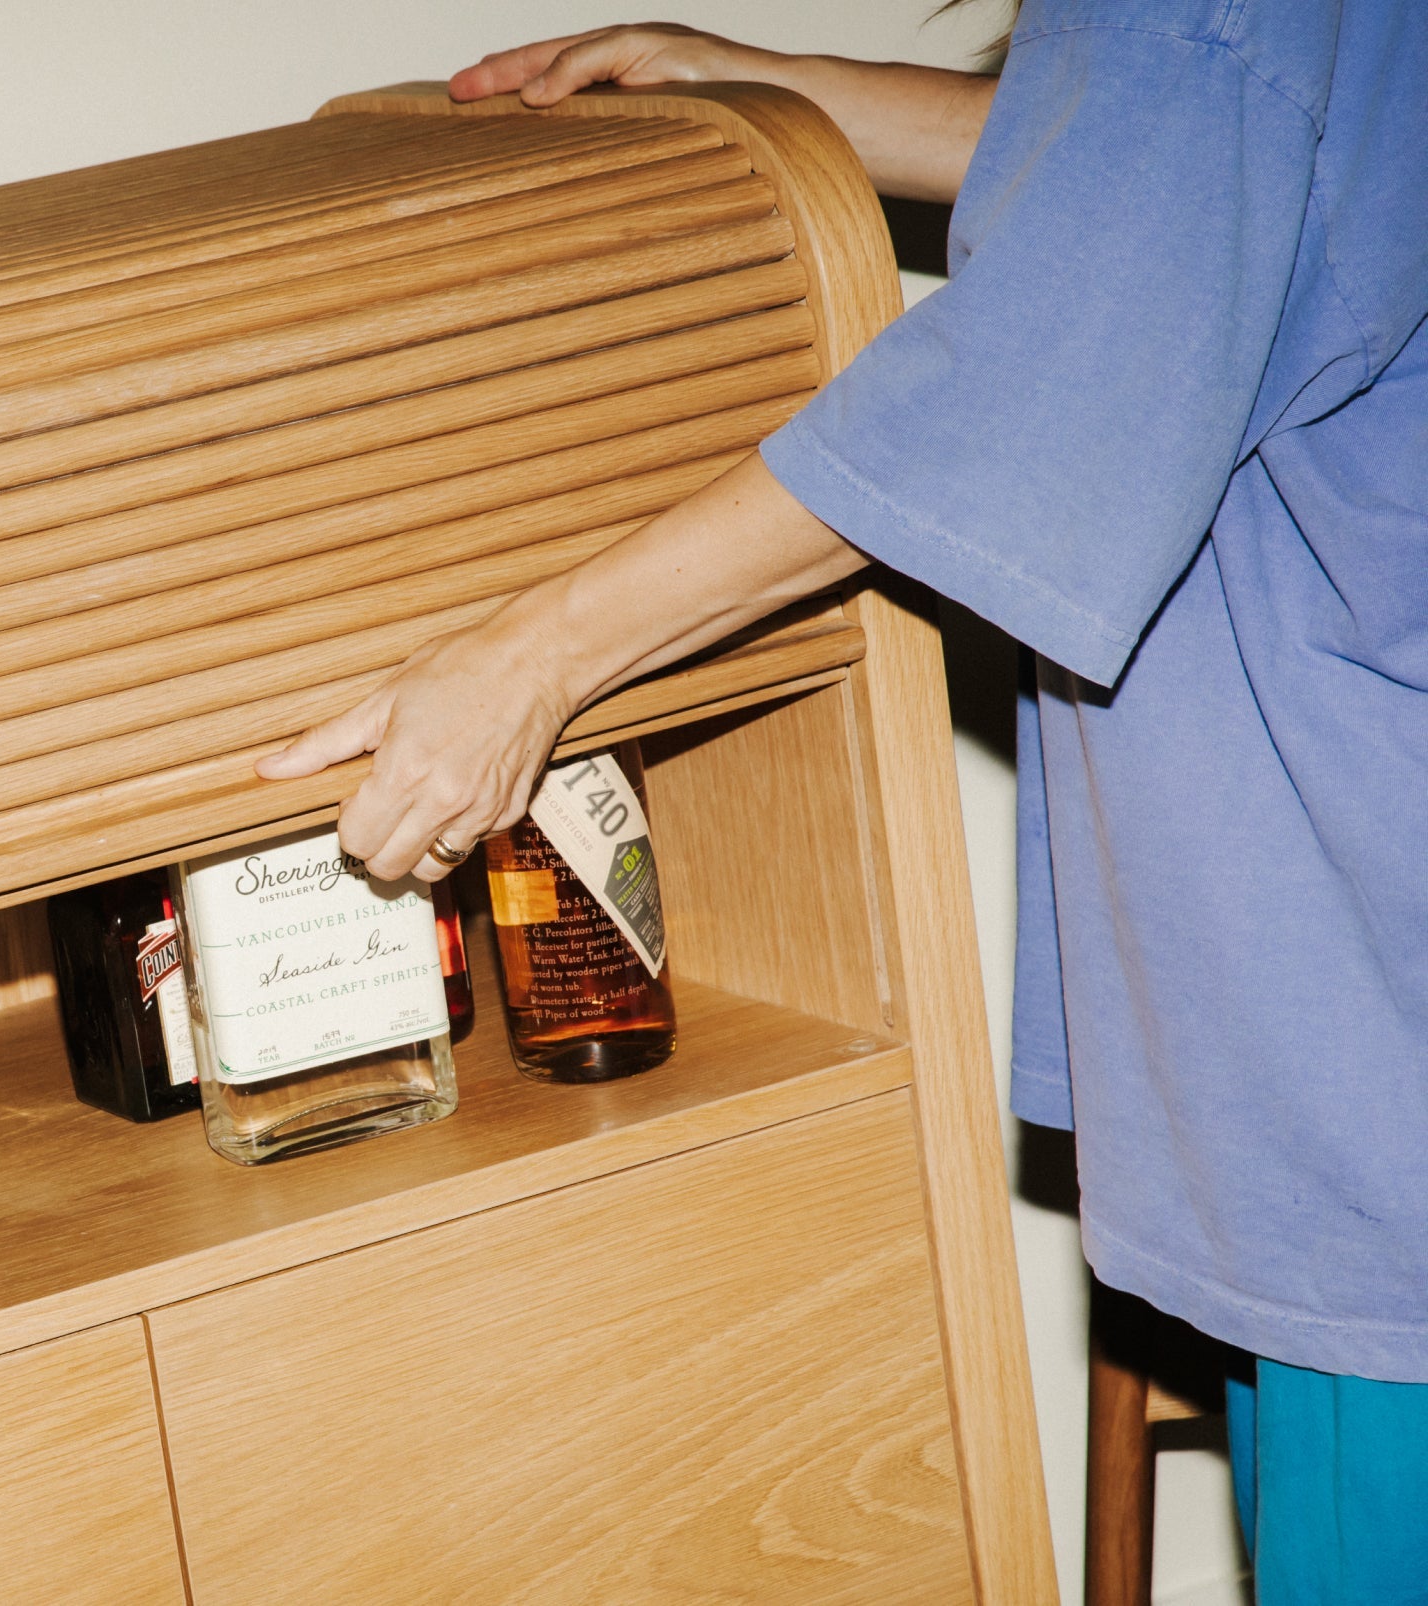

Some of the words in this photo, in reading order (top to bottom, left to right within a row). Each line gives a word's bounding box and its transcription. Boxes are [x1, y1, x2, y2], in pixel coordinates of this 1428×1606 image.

[584, 788, 629, 837] 40
[541, 859, 547, 868] 2
[259, 884, 315, 904] DISTILLERY
[574, 897, 580, 908] 5
[592, 909, 597, 919] 2
[236, 912, 347, 949] VANCOUVER
[355, 895, 418, 921] ISLAND
[545, 926, 593, 938] Percolators
[535, 942, 569, 951] Receiver
[571, 940, 584, 950] for
[586, 933, 619, 951] purified
[260, 952, 347, 988] Seaside
[353, 928, 411, 964] Gin
[532, 954, 556, 965] Warm
[558, 954, 585, 964] Water
[553, 968, 564, 981] by
[566, 966, 599, 977] wooden
[601, 962, 623, 976] pipes
[246, 992, 315, 1017] COASTAL
[320, 979, 368, 1000] CRAFT
[374, 964, 428, 987] SPIRITS
[540, 983, 563, 992] worm
[610, 990, 626, 1000] half
[545, 1009, 567, 1022] Pipes
[569, 1008, 579, 1018] of
[314, 1038, 342, 1051] BATCH
[258, 1054, 281, 1065] YEAR
